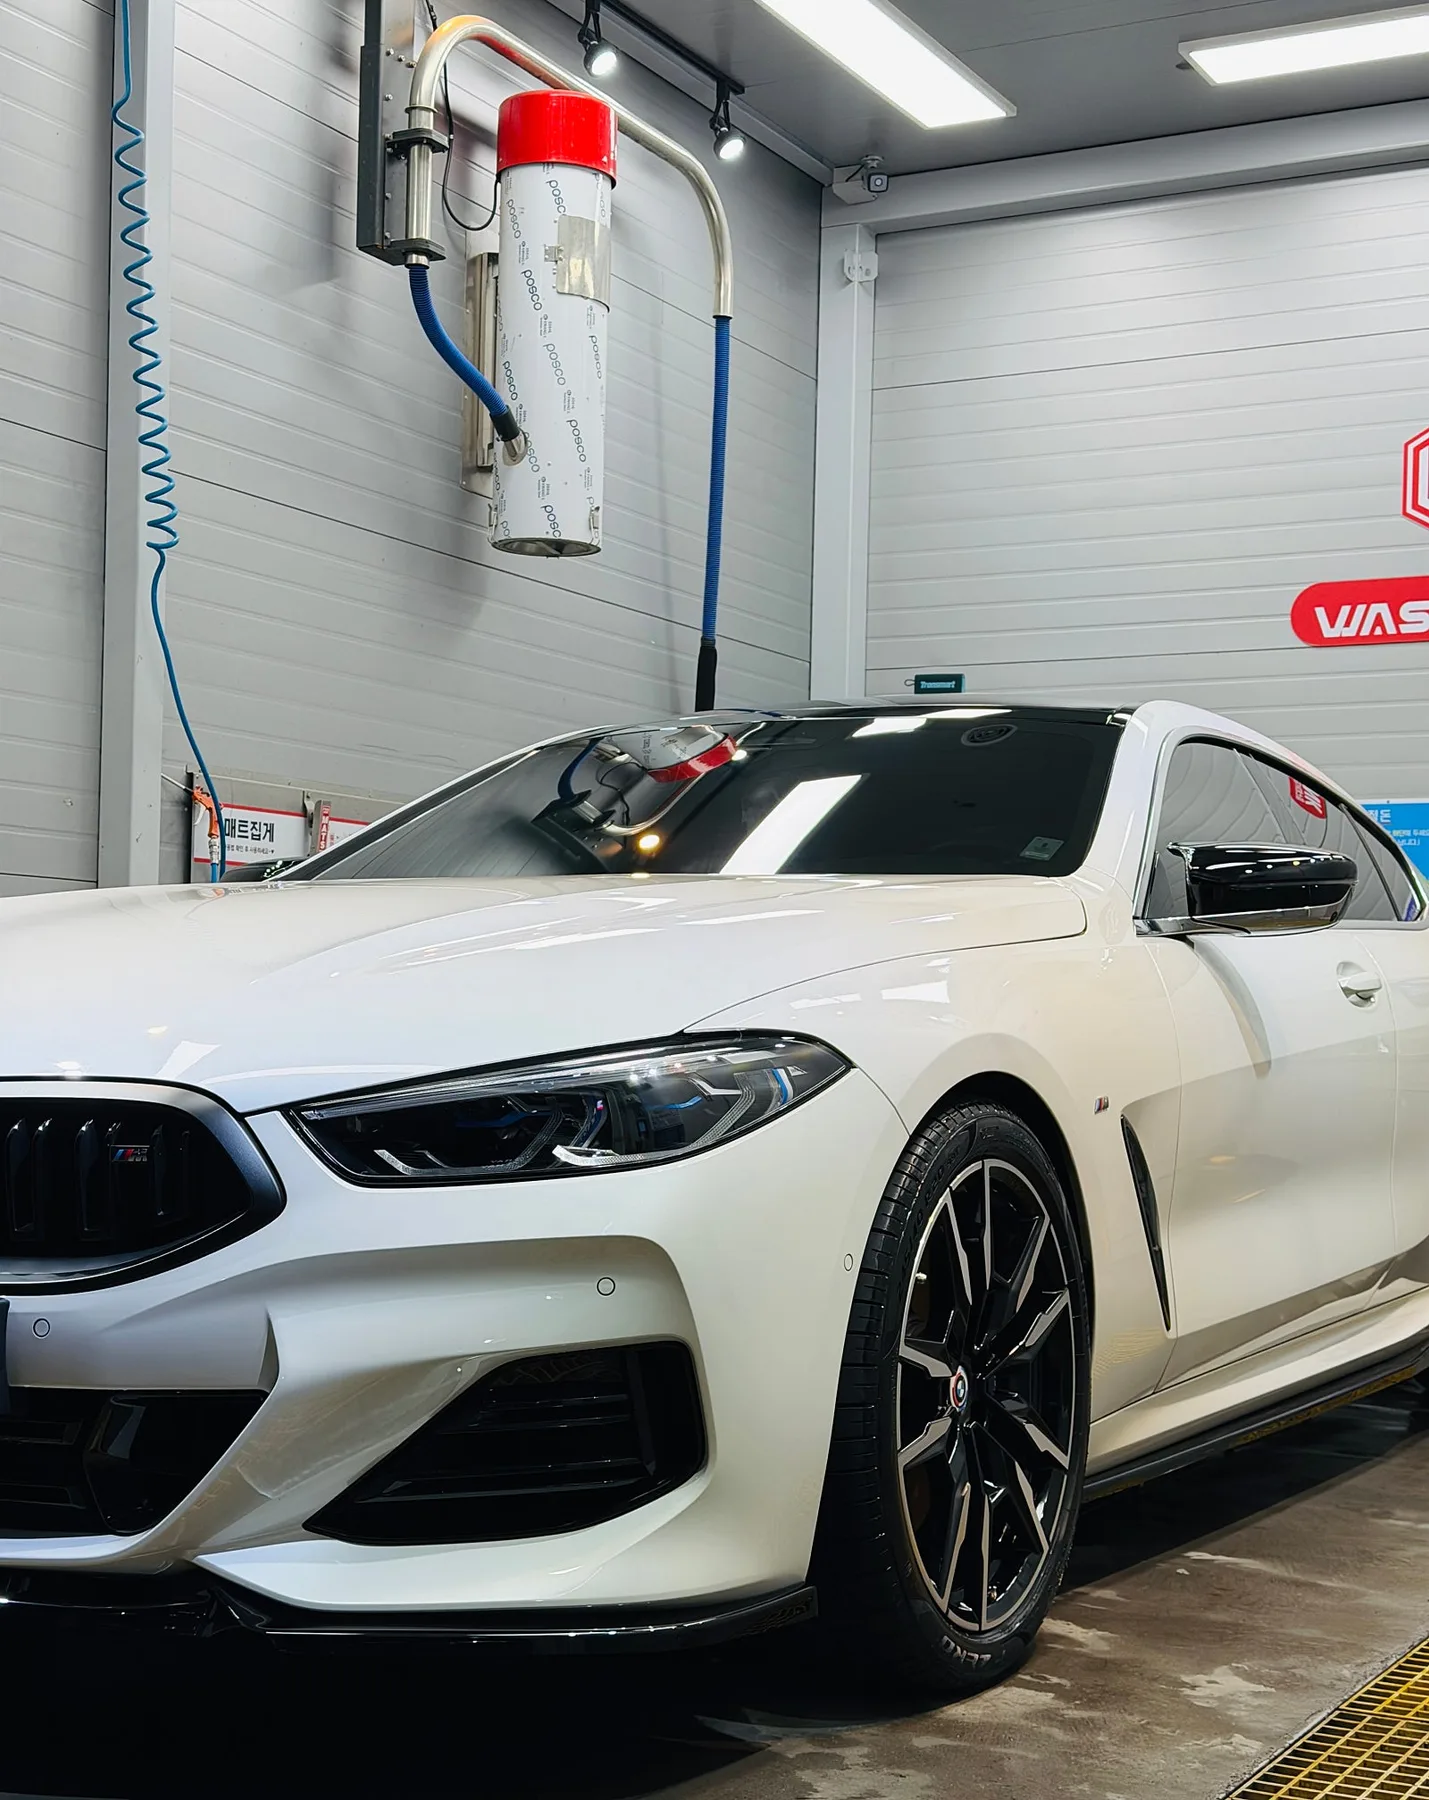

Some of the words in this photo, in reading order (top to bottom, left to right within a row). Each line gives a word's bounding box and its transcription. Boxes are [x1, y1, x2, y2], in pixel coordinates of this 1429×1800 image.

[546, 180, 567, 216] posc
[506, 199, 521, 239] posco
[521, 269, 542, 311] posco
[503, 361, 518, 401] posco
[543, 343, 566, 386] posco
[566, 419, 586, 462] posco
[225, 818, 274, 842] 매트집게
